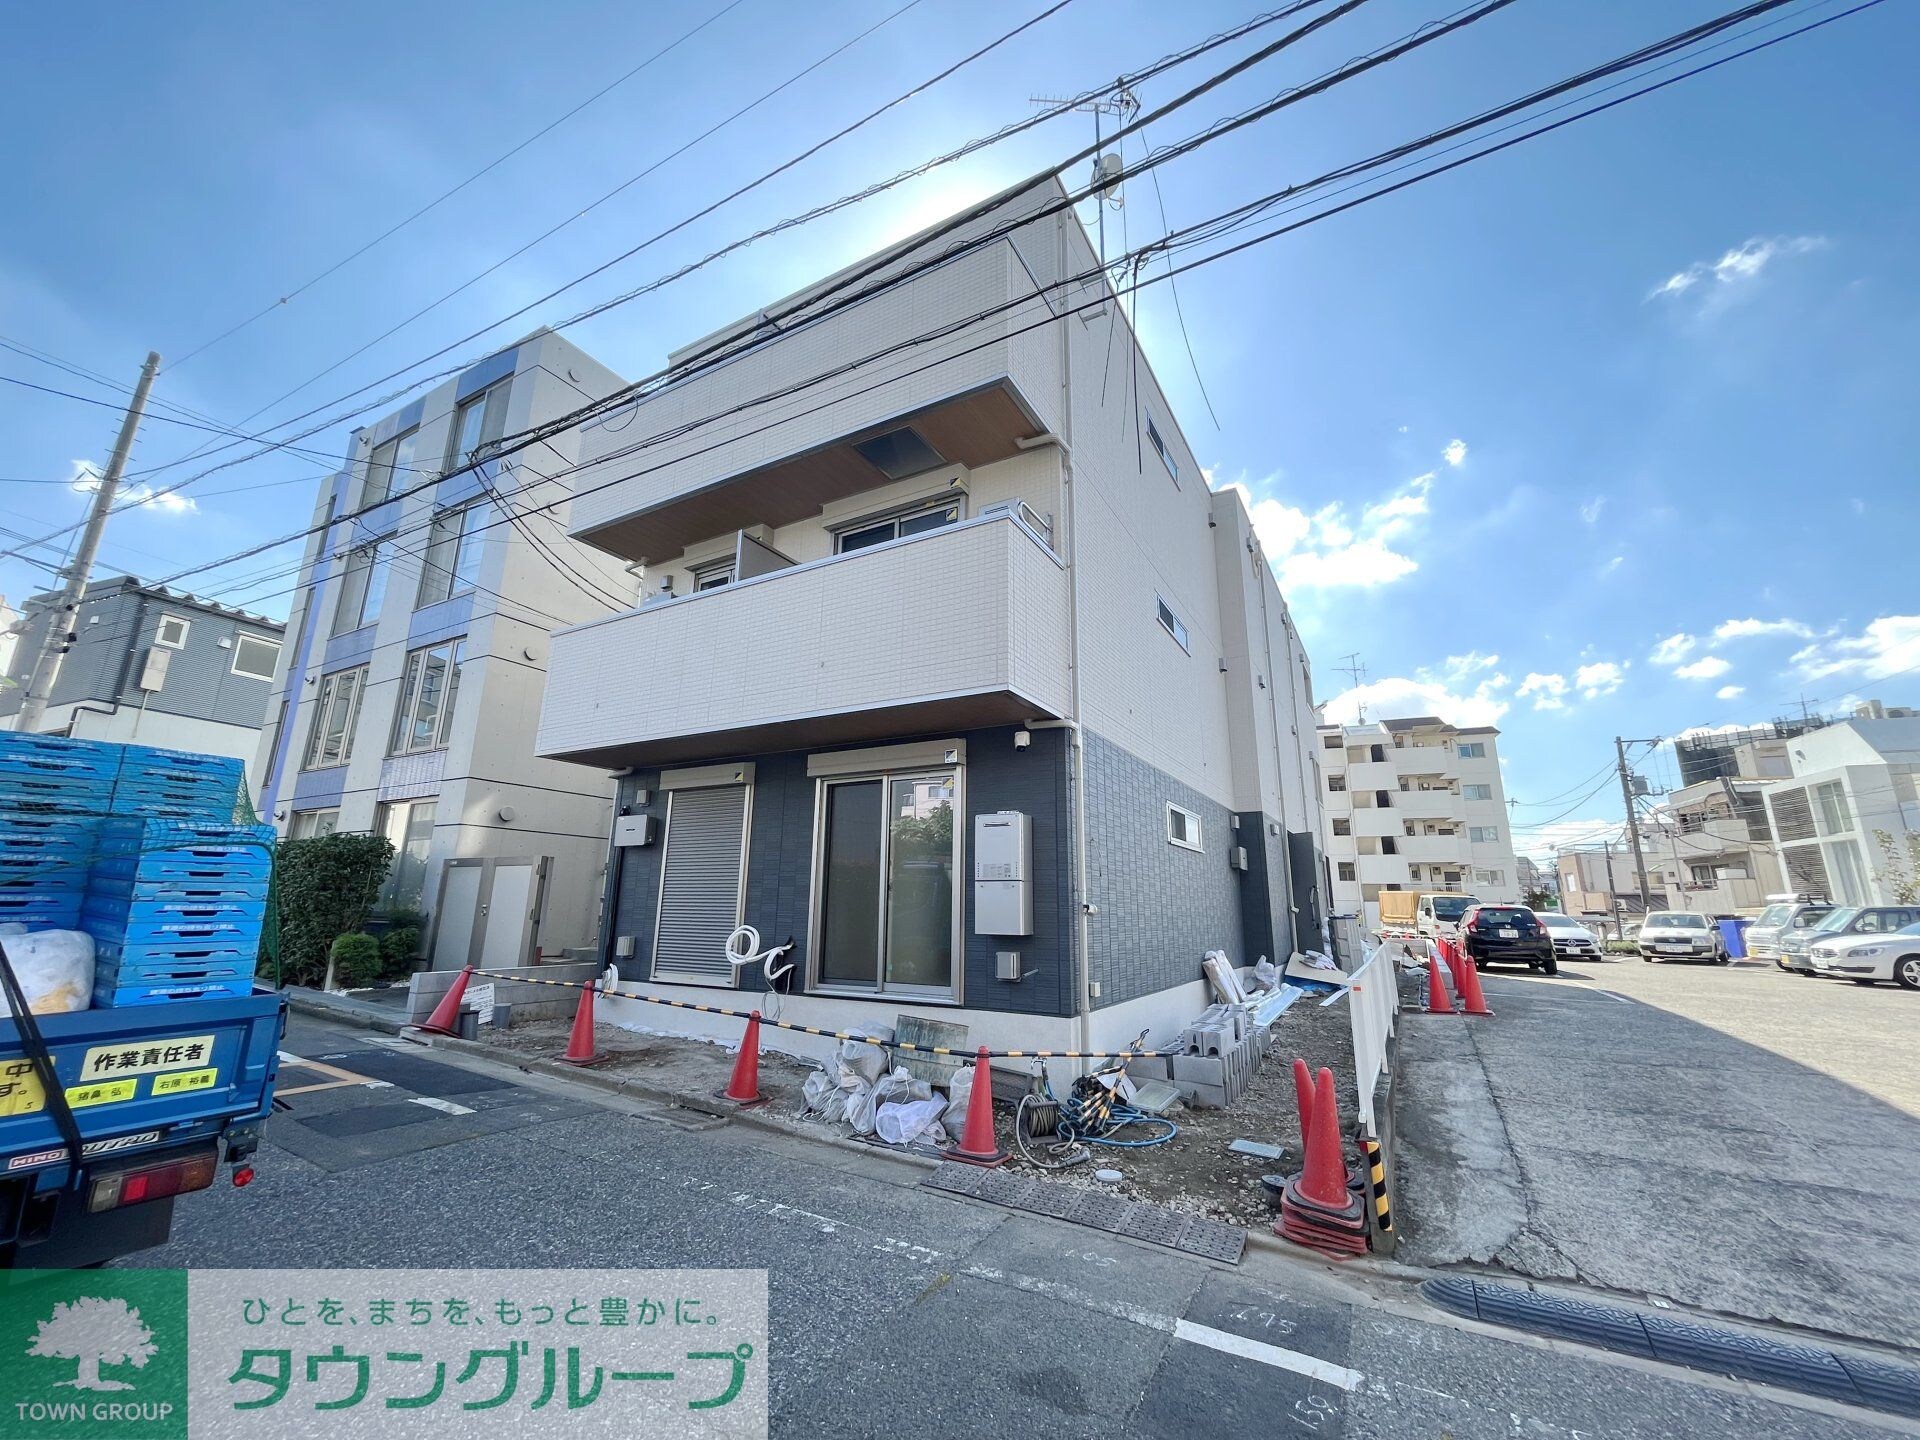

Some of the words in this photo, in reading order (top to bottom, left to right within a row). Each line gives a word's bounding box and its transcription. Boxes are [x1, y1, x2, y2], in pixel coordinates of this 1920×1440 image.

[93, 1043, 205, 1072] 作業責任者
[11, 1152, 61, 1167] HINO
